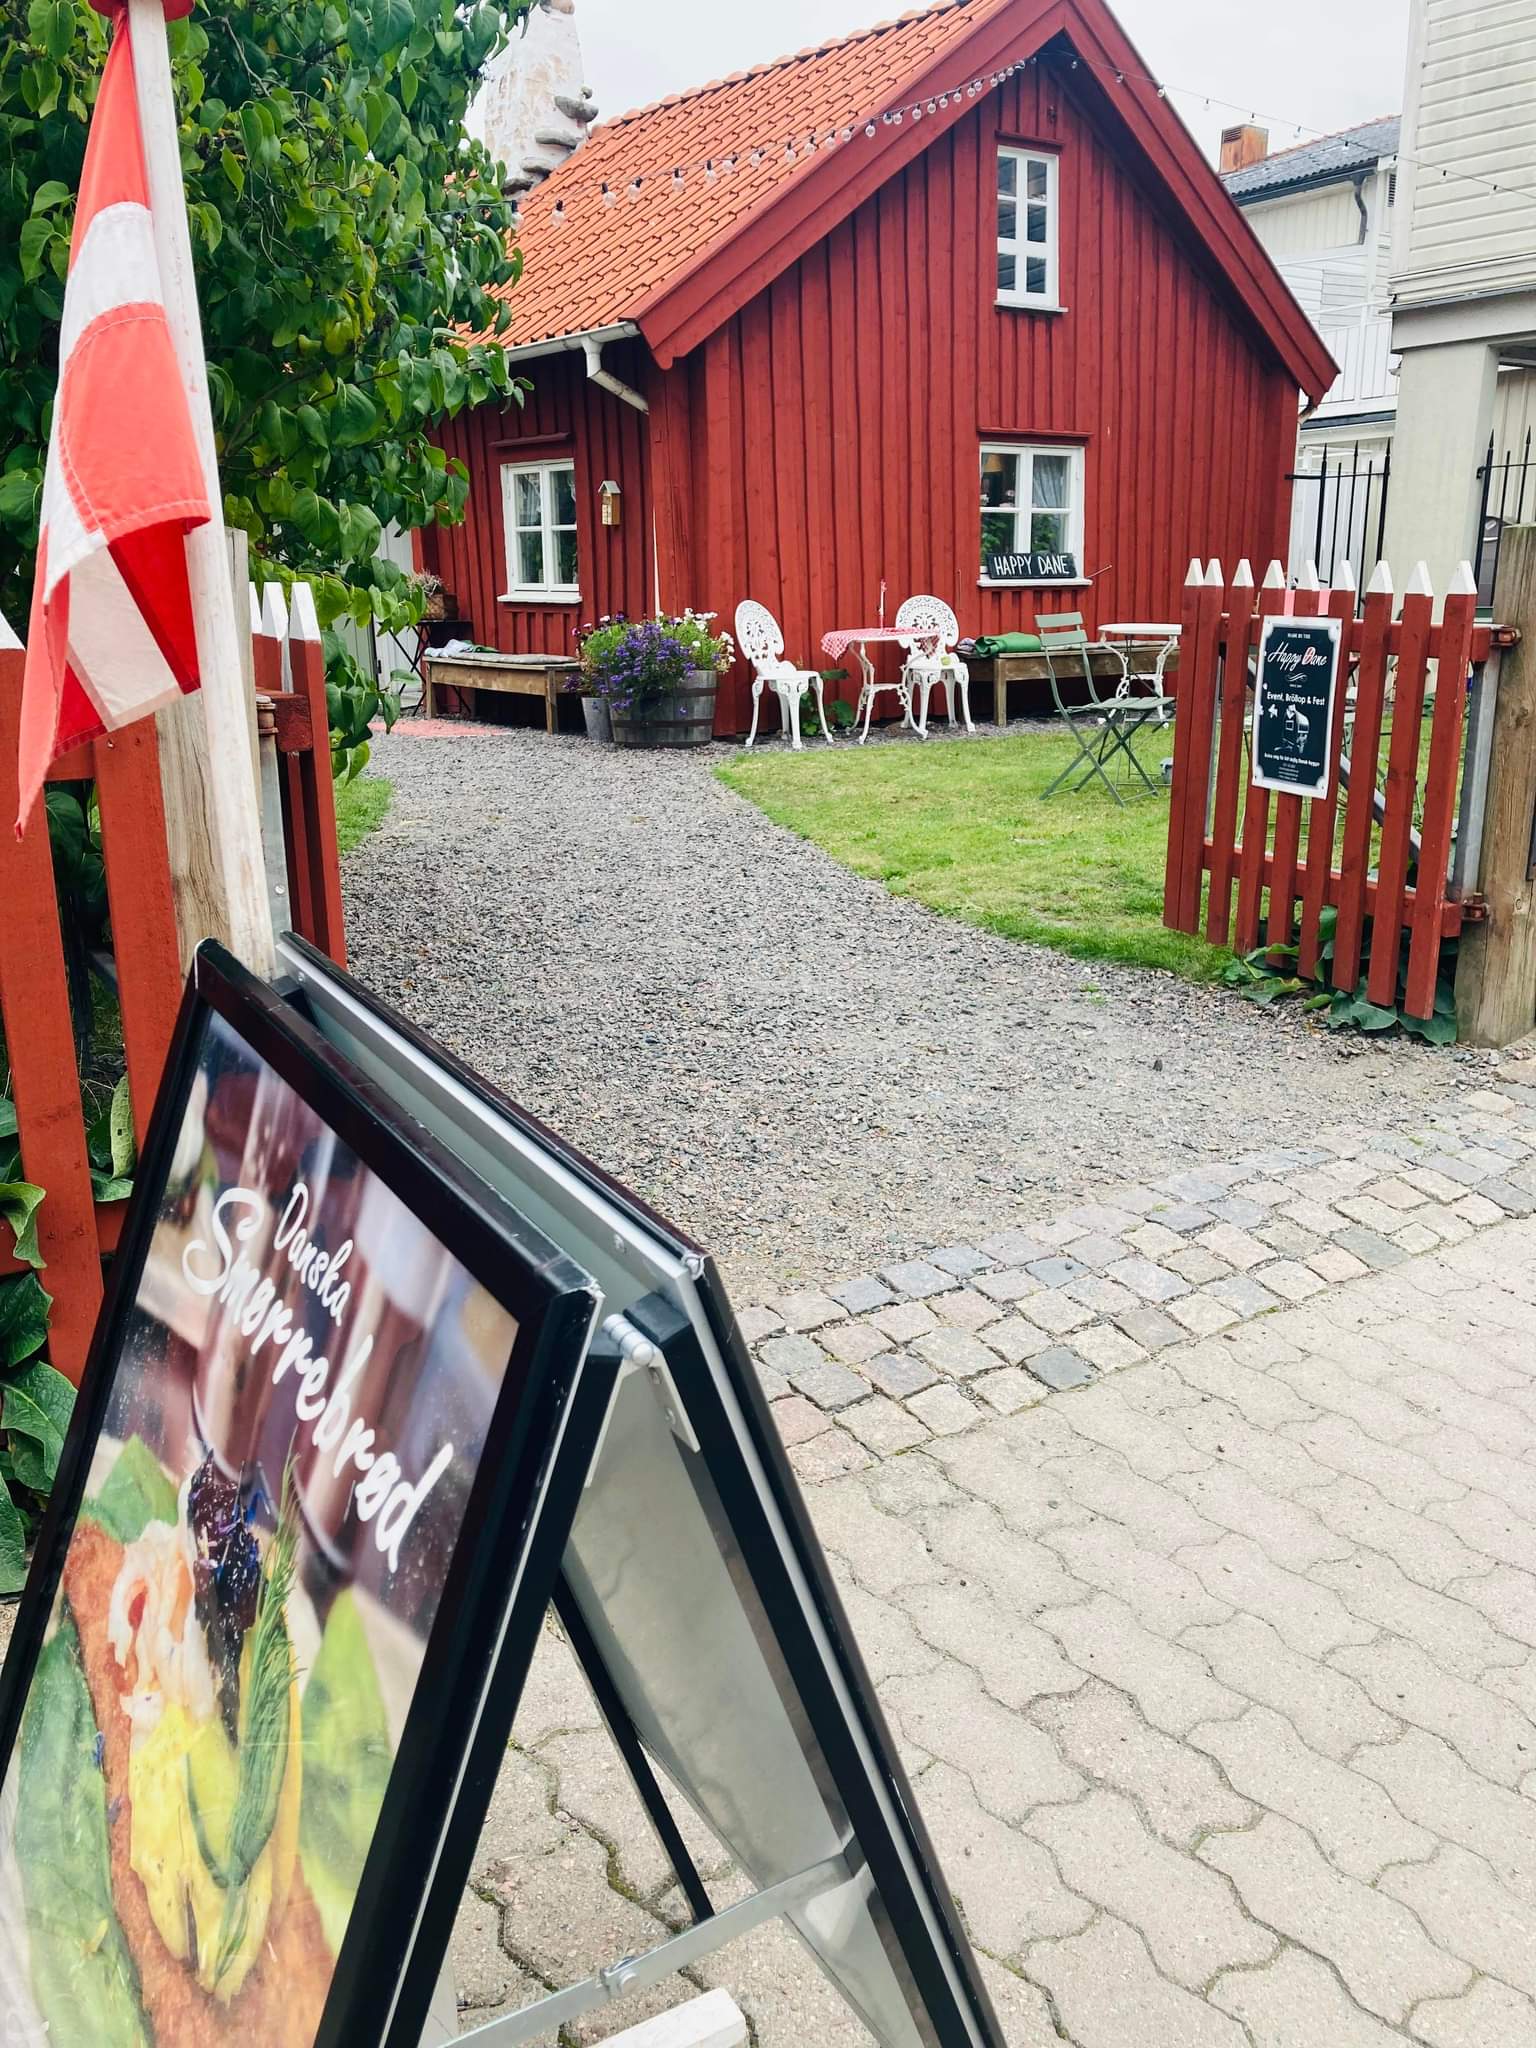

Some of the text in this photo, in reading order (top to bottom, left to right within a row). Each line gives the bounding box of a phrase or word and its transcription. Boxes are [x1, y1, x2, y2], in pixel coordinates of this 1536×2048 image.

[993, 554, 1070, 576] HAPPY DANE
[1267, 641, 1328, 672] Happy Dane
[1285, 693, 1306, 705] Bröllop
[1313, 696, 1325, 706] Fest
[274, 1181, 353, 1327] Danska
[181, 1187, 455, 1574] Smørrebrød
